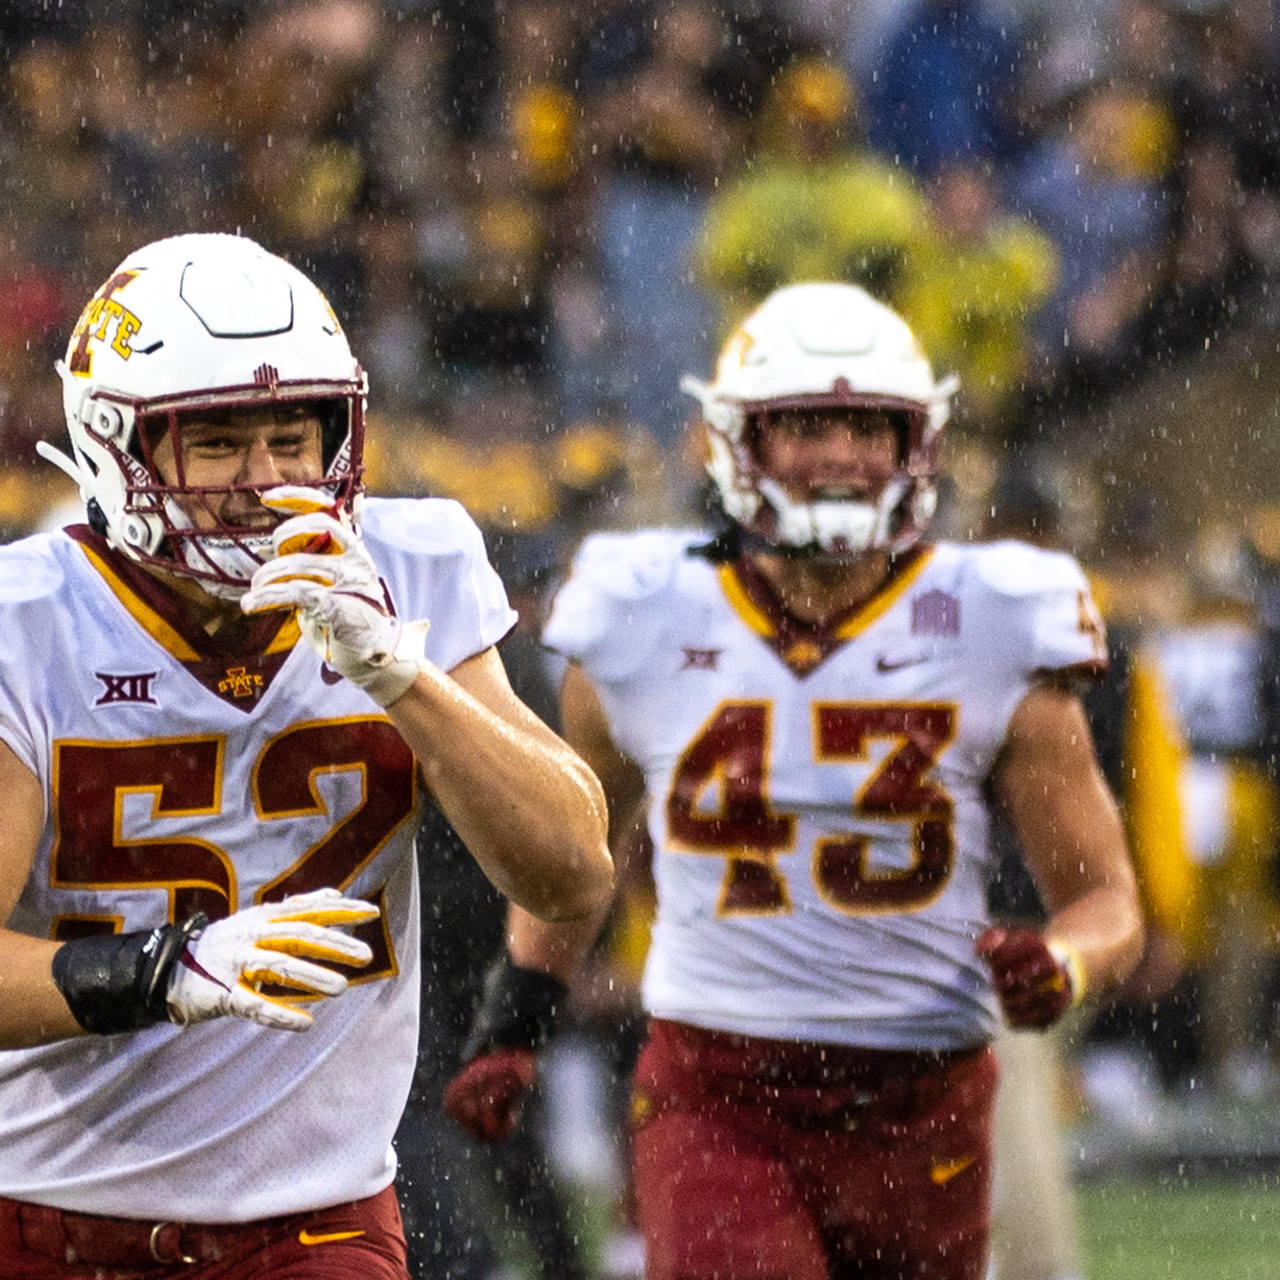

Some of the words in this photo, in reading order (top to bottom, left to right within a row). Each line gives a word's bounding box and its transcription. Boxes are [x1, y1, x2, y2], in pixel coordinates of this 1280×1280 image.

[95, 671, 157, 706] XII
[218, 673, 264, 693] STATE
[49, 714, 417, 1003] 52
[664, 699, 960, 918] 43
